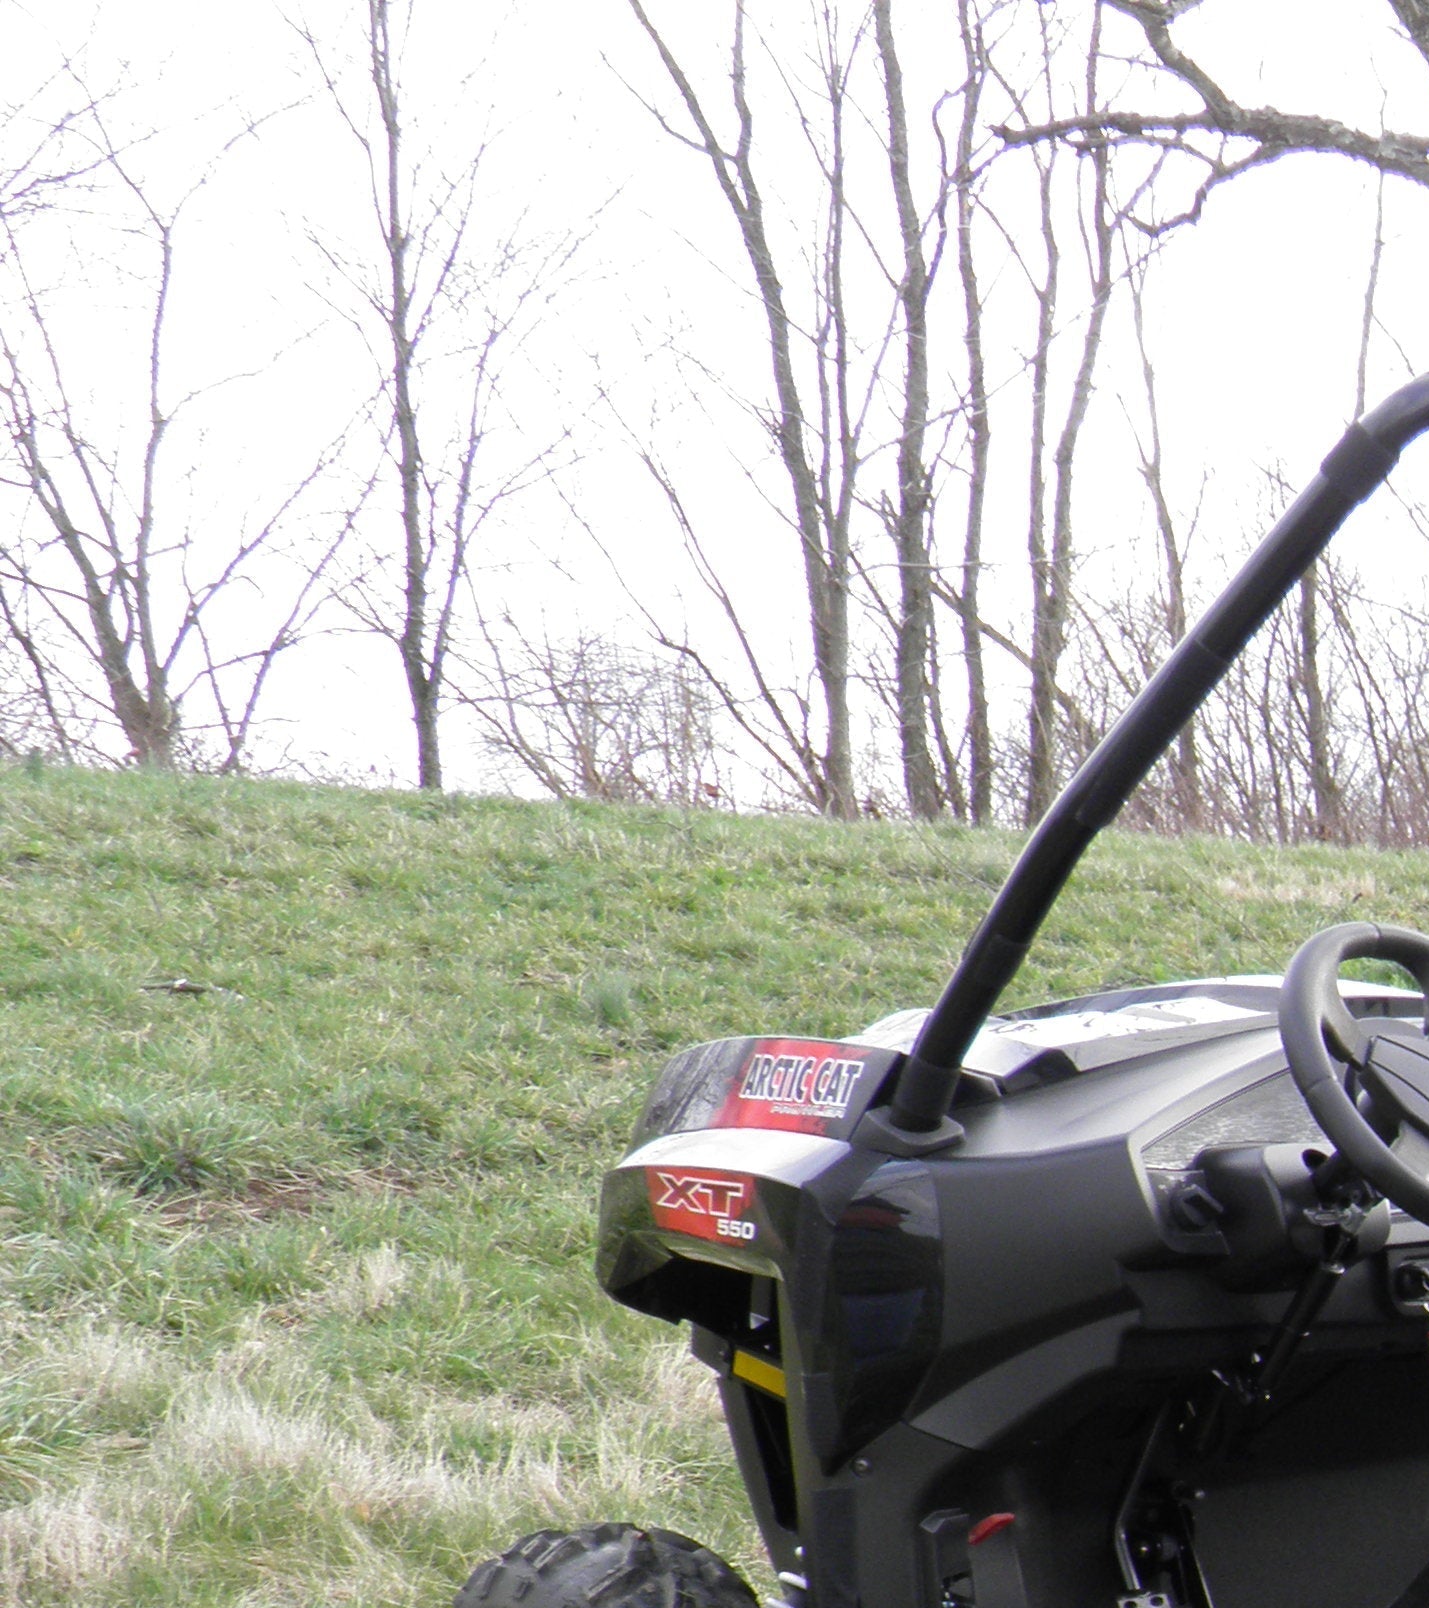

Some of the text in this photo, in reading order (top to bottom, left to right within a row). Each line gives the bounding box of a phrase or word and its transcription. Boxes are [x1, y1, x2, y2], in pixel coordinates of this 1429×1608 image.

[739, 1054, 865, 1107] ARCTIC CAT
[656, 1172, 744, 1217] XT
[717, 1219, 756, 1240] 550
